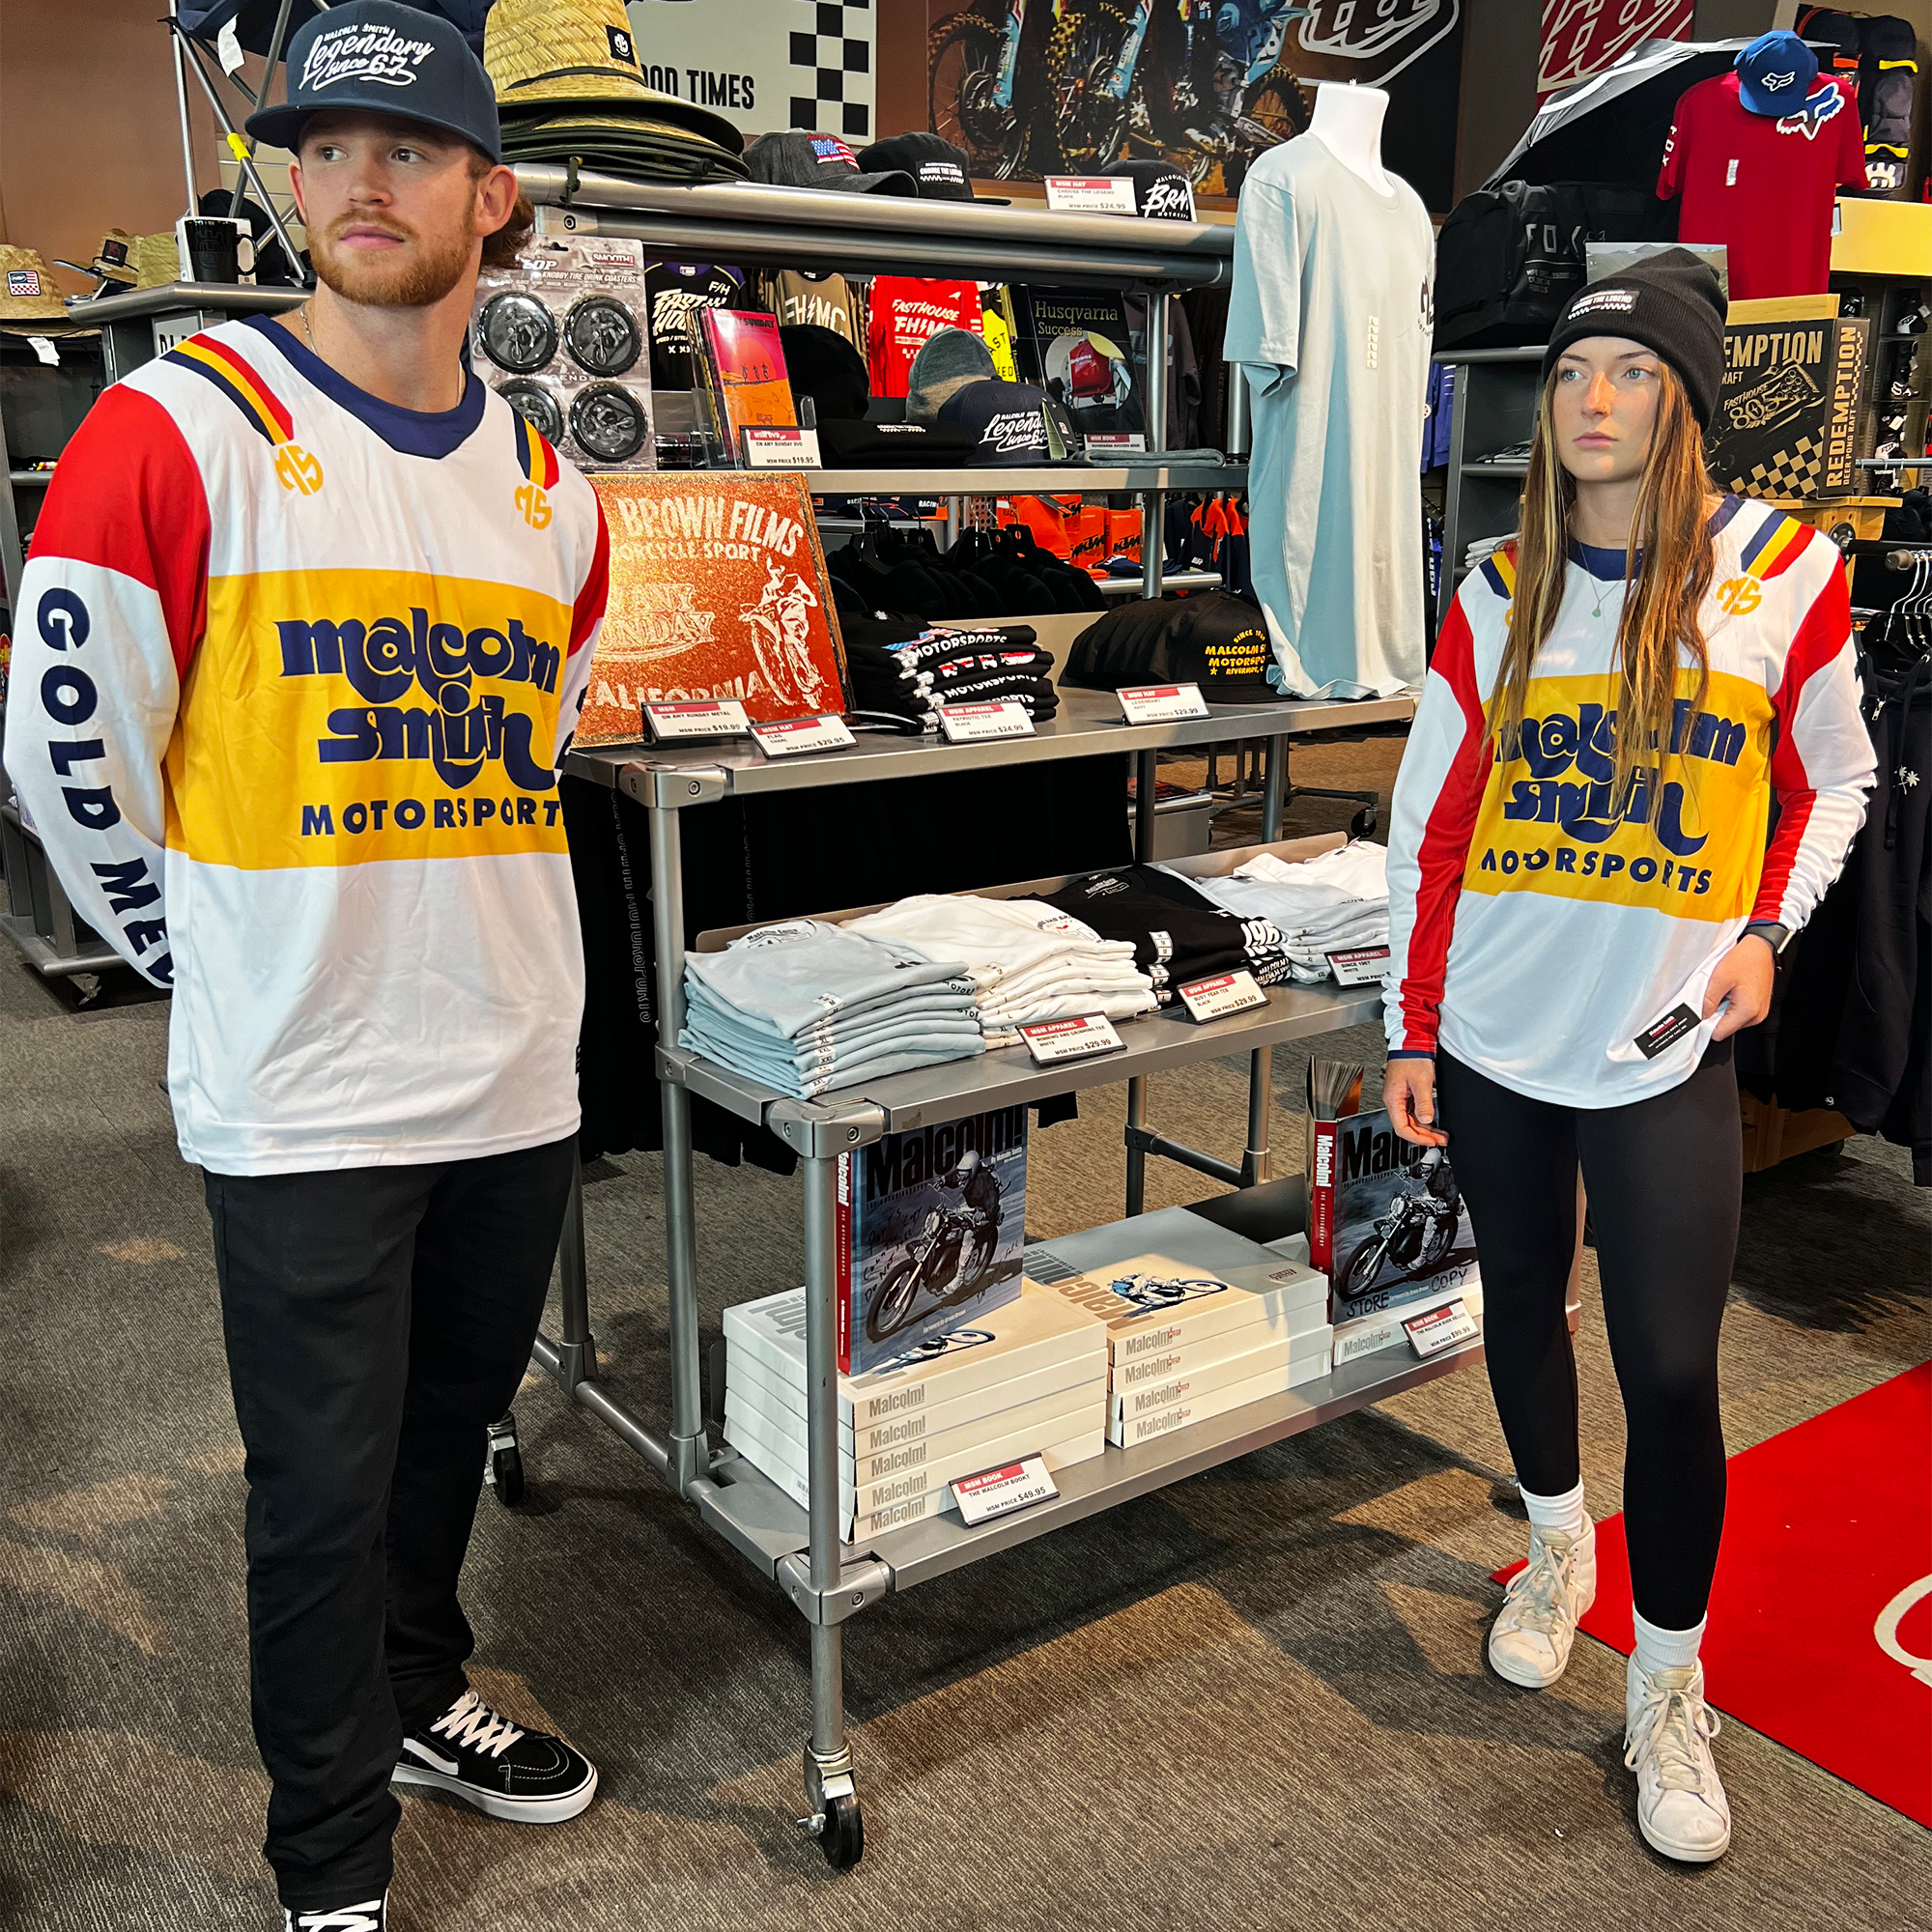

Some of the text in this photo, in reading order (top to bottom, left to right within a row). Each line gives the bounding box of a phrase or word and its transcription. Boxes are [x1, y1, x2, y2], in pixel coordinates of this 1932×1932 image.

[368, 54, 409, 76] 67
[686, 69, 754, 110] TIMES
[604, 273, 638, 284] COASTERS
[892, 298, 960, 322] FASTHOUSE
[1035, 300, 1119, 324] Husqvarna
[1605, 295, 1633, 304] LEGEND
[1037, 322, 1083, 337] Success
[1723, 330, 1824, 368] EMPTION
[1723, 384, 1769, 412] FASTHOUSE
[1827, 327, 1858, 489] REDEMPTION
[1847, 410, 1857, 433] RAFT
[616, 497, 804, 557] BROWN FILMS
[704, 543, 761, 561] SPORT
[913, 634, 1008, 659] MOTORSPORTS
[1233, 629, 1253, 644] SINCE
[274, 607, 561, 704] malcolm
[1205, 645, 1259, 656] MALCOLM
[594, 670, 767, 711] ALIFORNIA
[37, 586, 121, 832] GOLD
[318, 680, 557, 792] smith
[301, 797, 562, 837] MOTORSPORT
[1240, 919, 1281, 948] 196
[1353, 951, 1382, 959] APPAREL
[1202, 979, 1228, 991] APPAREL
[1030, 1021, 1078, 1035] MSM APPAREL
[1084, 1037, 1112, 1050] $29.99
[867, 1103, 1024, 1202] Malcolm!
[1316, 1134, 1333, 1187] Malcolm!
[1431, 1268, 1467, 1293] COPY
[1347, 1292, 1390, 1318] STORE
[1424, 1314, 1439, 1324] BOOK
[1451, 1325, 1470, 1340] $99.99
[868, 1383, 924, 1418] Malcolm!
[869, 1414, 925, 1450] Malcolm!
[870, 1442, 926, 1478] Malcolm!
[871, 1470, 927, 1506] Malcolm!
[963, 1472, 1004, 1490] MSM BOOK
[968, 1490, 980, 1498] THE
[981, 1481, 1009, 1494] MALCOLM
[985, 1486, 1046, 1512] MSM PRICE $49.95
[869, 1496, 926, 1532] Malcolm!
